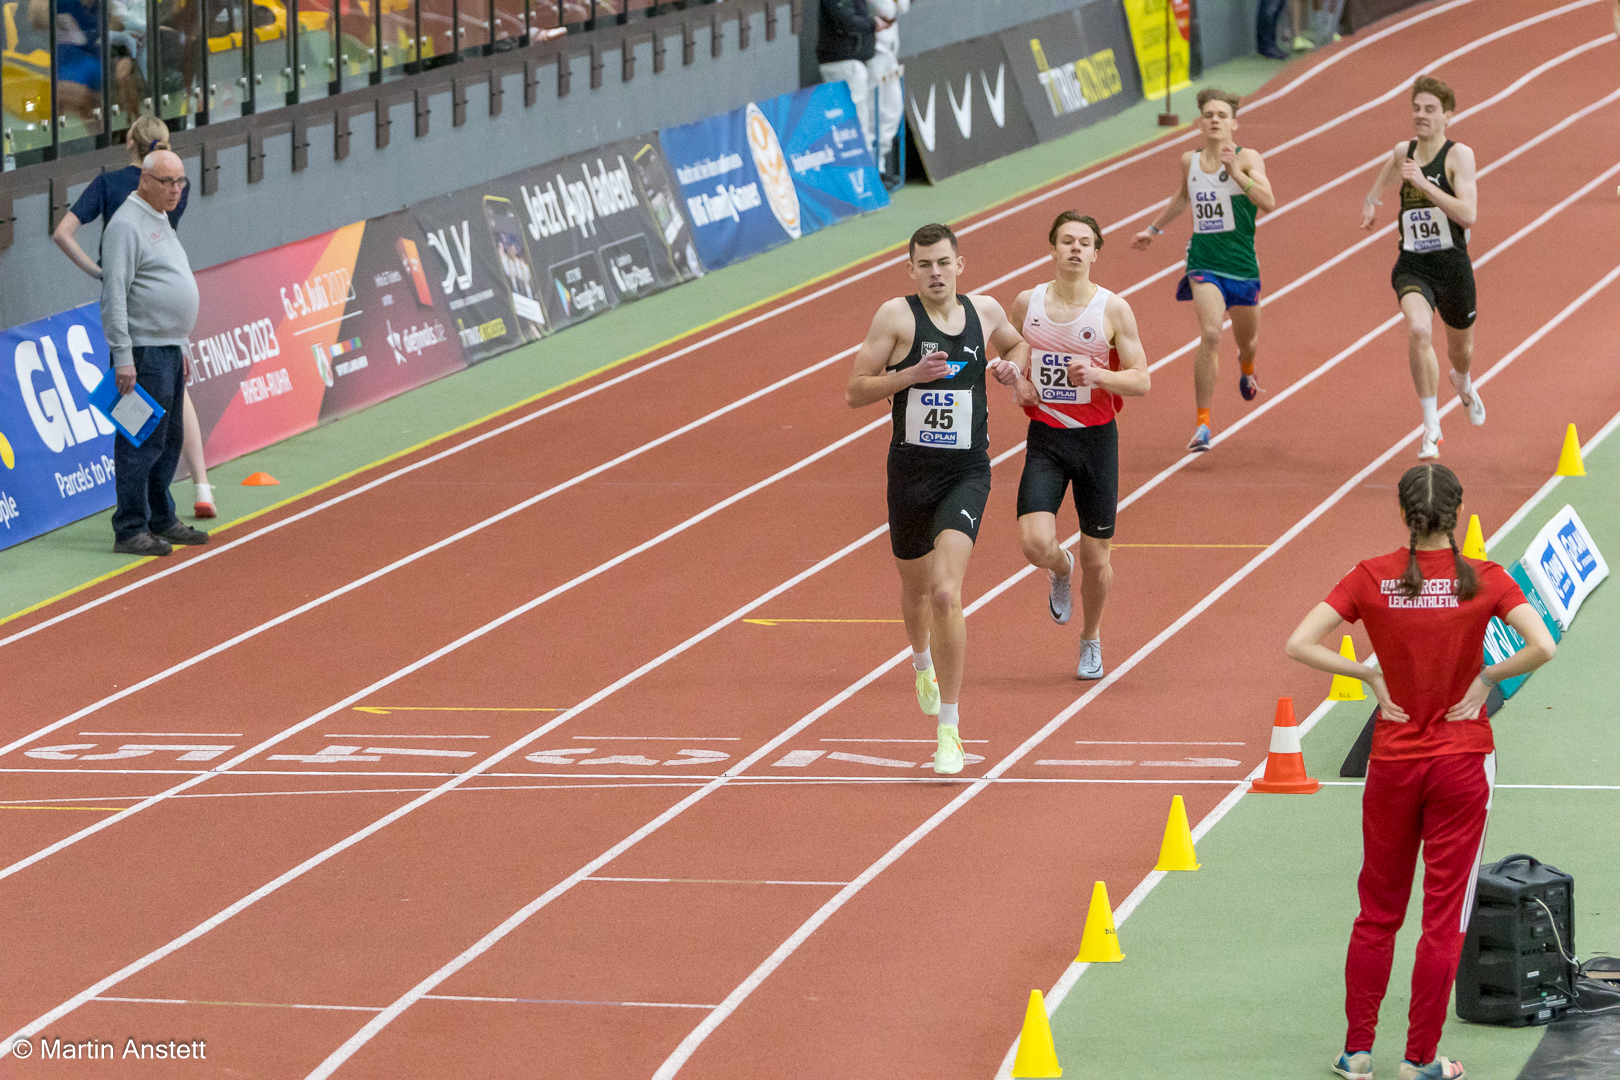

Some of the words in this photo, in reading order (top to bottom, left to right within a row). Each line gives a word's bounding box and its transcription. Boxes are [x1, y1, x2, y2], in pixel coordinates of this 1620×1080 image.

[520, 181, 567, 241] Jetzt
[557, 174, 597, 239] App
[581, 155, 639, 217] laden!
[1196, 203, 1224, 219] 304
[1410, 222, 1441, 239] 194
[323, 268, 356, 307] 2023
[198, 327, 251, 379] FINALS
[243, 317, 280, 363] 2023
[15, 325, 116, 453] GLS
[240, 368, 293, 405] RHEIN-RUHR
[1056, 390, 1076, 399] PLAN
[924, 409, 954, 430] 45
[934, 433, 956, 442] PLAN
[54, 462, 95, 499] Parcels
[90, 461, 106, 485] to
[1388, 595, 1460, 609] LEICHTATHLETIK
